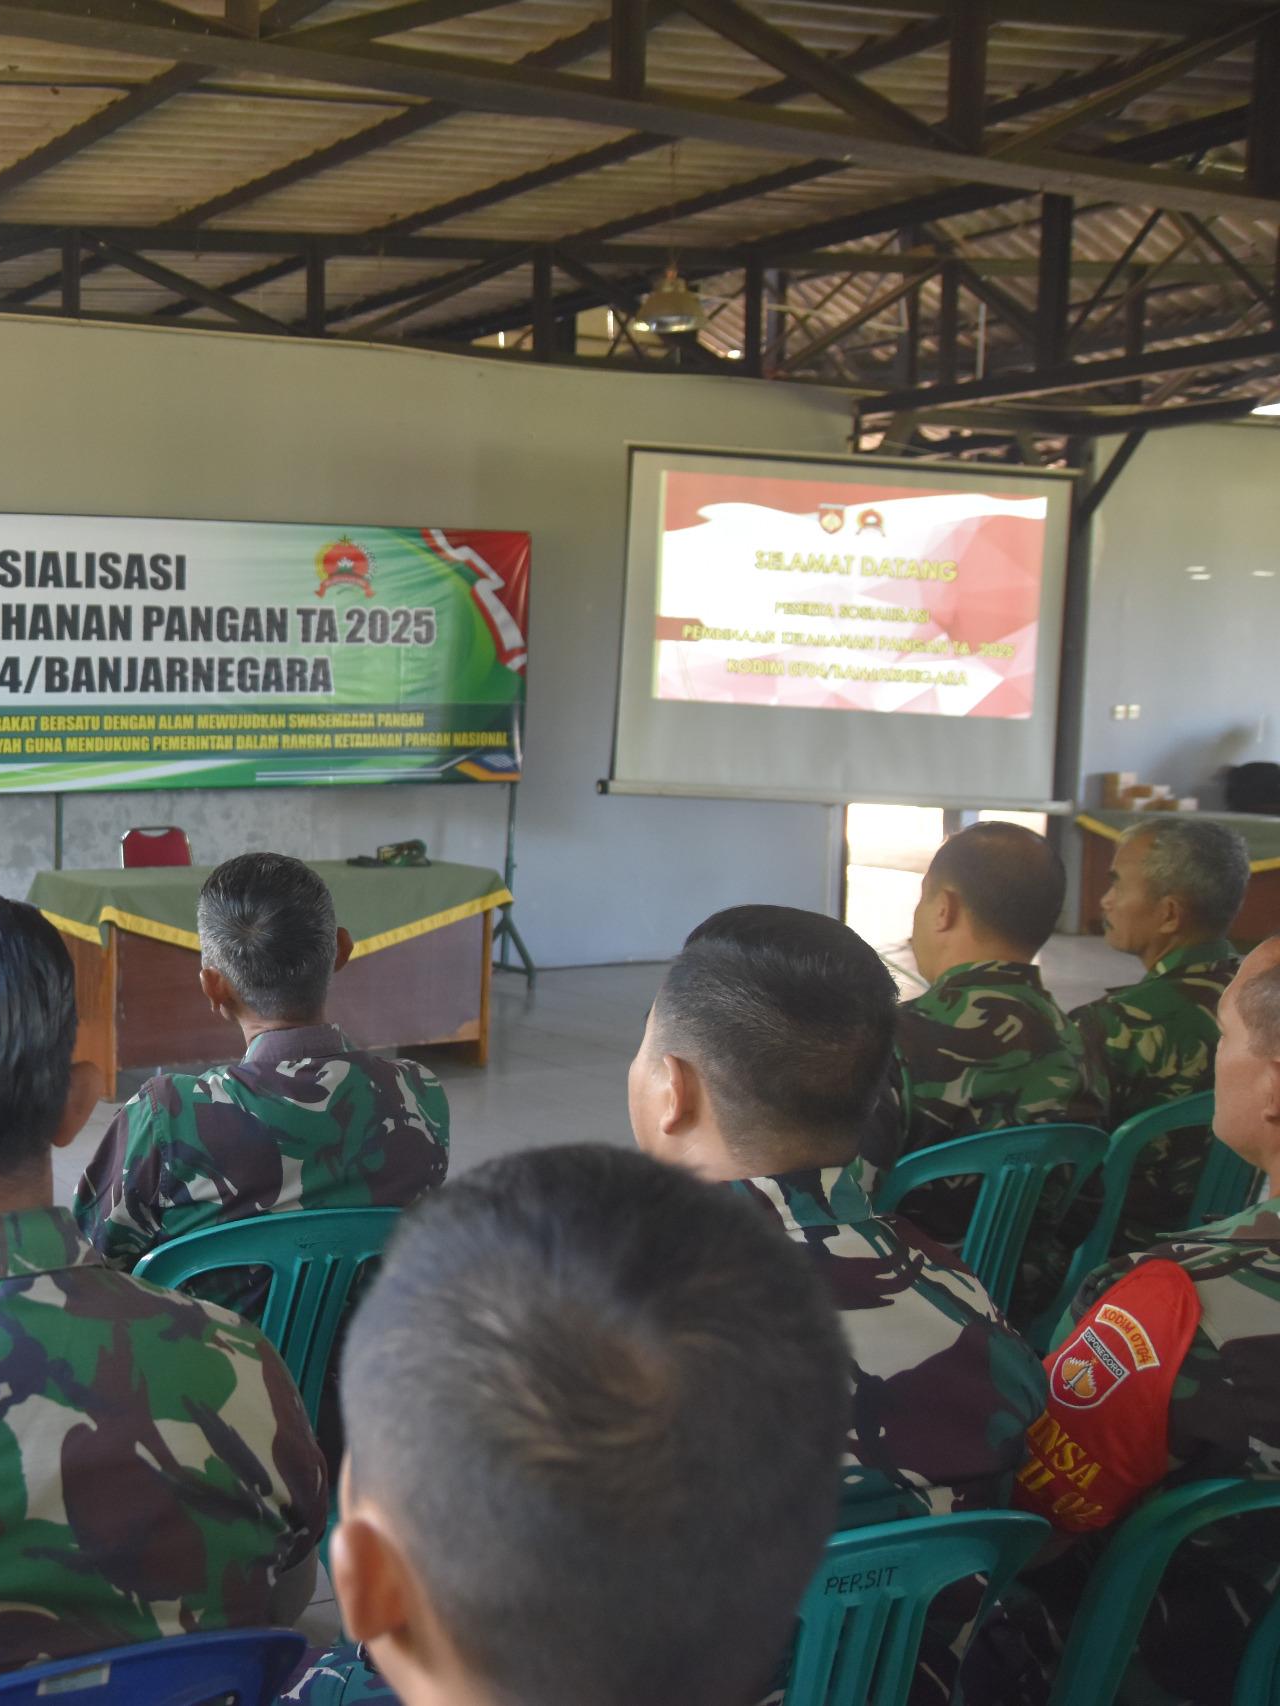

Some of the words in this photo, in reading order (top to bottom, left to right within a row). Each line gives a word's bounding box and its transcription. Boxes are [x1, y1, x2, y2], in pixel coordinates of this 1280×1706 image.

[755, 550, 854, 576] SELAMAT
[860, 556, 959, 582] DATANG
[142, 605, 289, 642] PANGAN
[296, 608, 339, 643] TA
[345, 608, 436, 644] 2025
[40, 715, 100, 731] BERSATU
[103, 714, 156, 730] DENGAN
[159, 714, 194, 730] ALAM
[197, 713, 286, 729] MEWUJUDKAN
[288, 713, 375, 729] SWASEMBADA
[377, 712, 425, 728] PANGAN
[25, 737, 63, 753] GUNA
[66, 735, 150, 752] MENDUKUNG
[153, 735, 234, 751] PEMERINTAH
[236, 734, 280, 750] DALAM
[282, 734, 332, 750] RANGKA
[334, 733, 403, 749] KETAHANAN
[405, 732, 451, 748] PANGAN
[453, 731, 509, 748] NASIONAL
[1083, 1330, 1124, 1377] DIPONEGORO
[1101, 1308, 1136, 1335] KODIM
[1130, 1333, 1153, 1365] 0704
[1026, 1408, 1102, 1490] INSA
[823, 1566, 899, 1596] PERSIT
